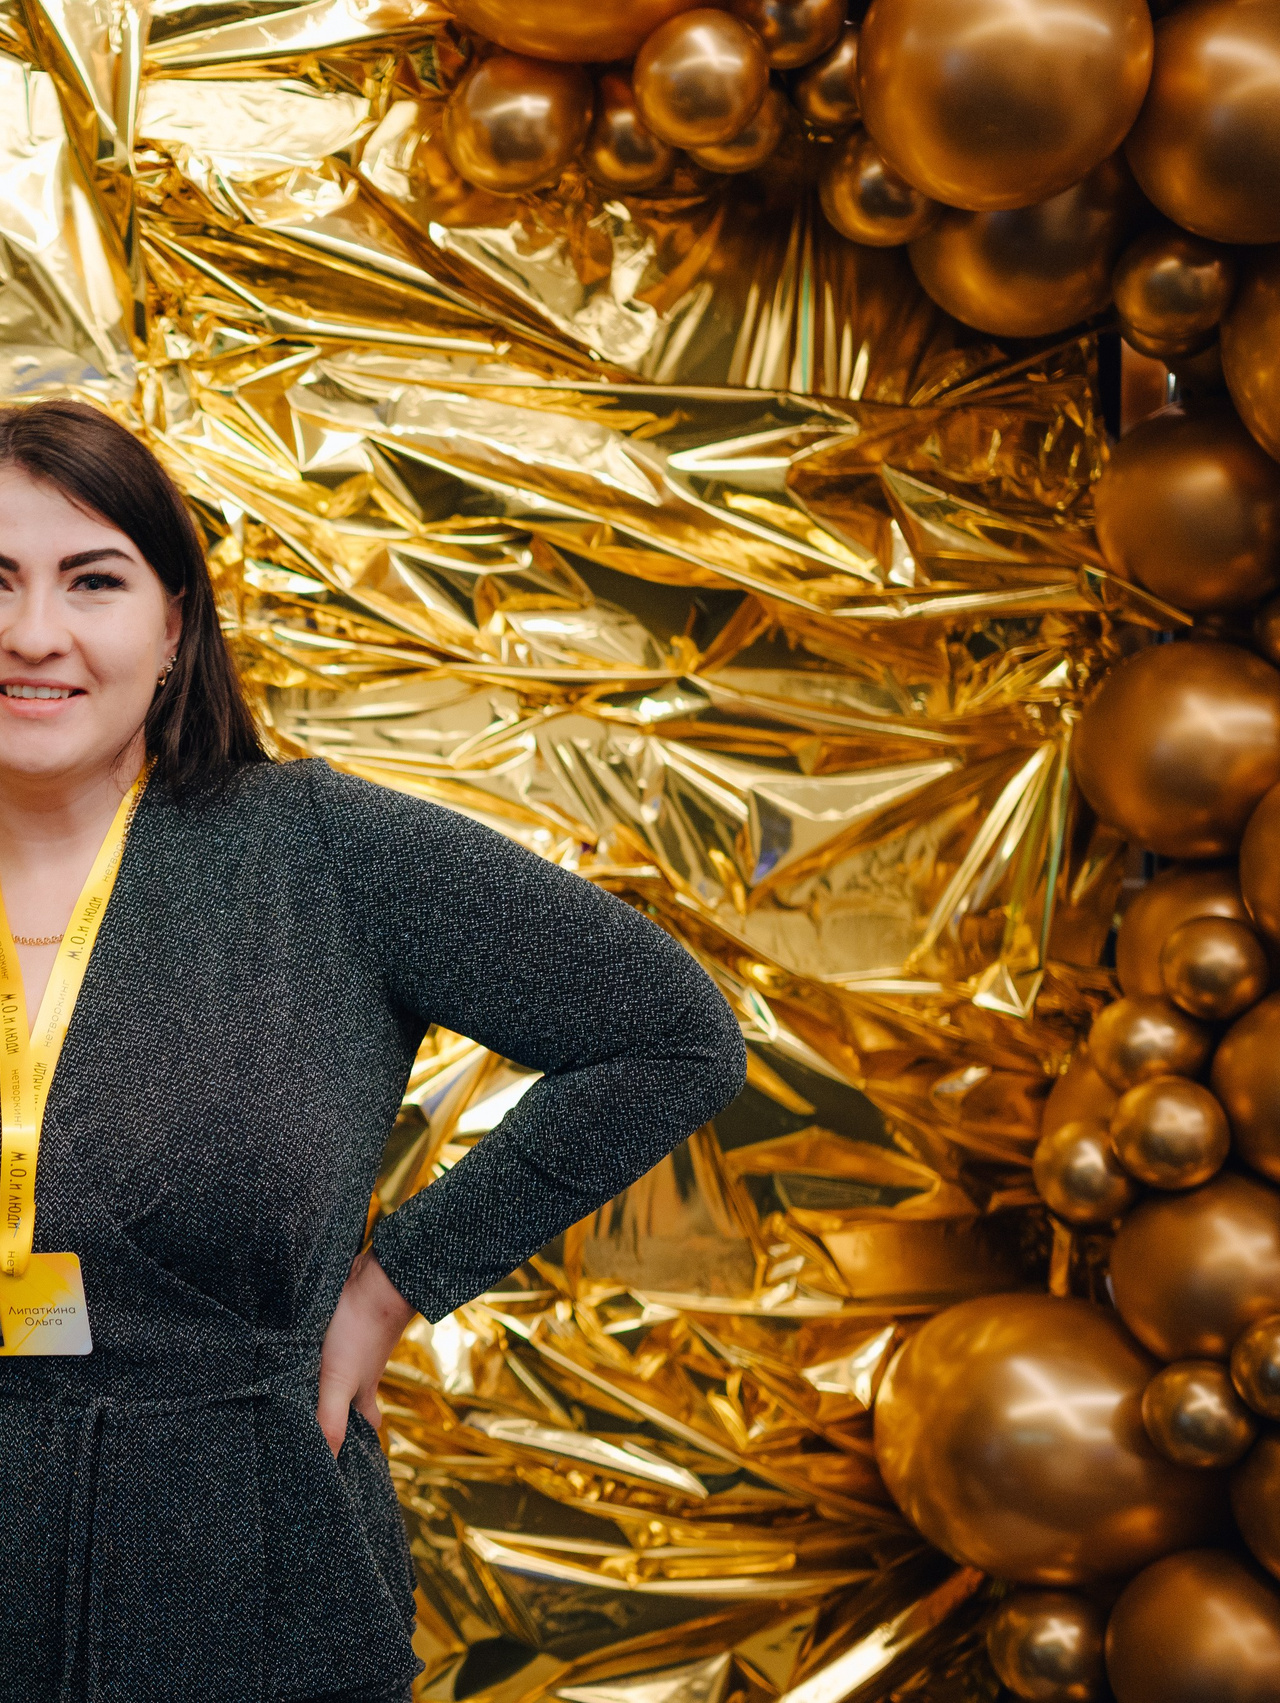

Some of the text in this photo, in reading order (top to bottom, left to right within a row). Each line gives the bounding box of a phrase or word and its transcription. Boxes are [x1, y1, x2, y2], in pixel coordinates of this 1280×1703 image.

[43, 979, 70, 1048] нетворкинг
[11, 1068, 23, 1129] нетворкинг
[8, 1306, 76, 1315] Липаткина
[24, 1317, 63, 1326] Ольга
